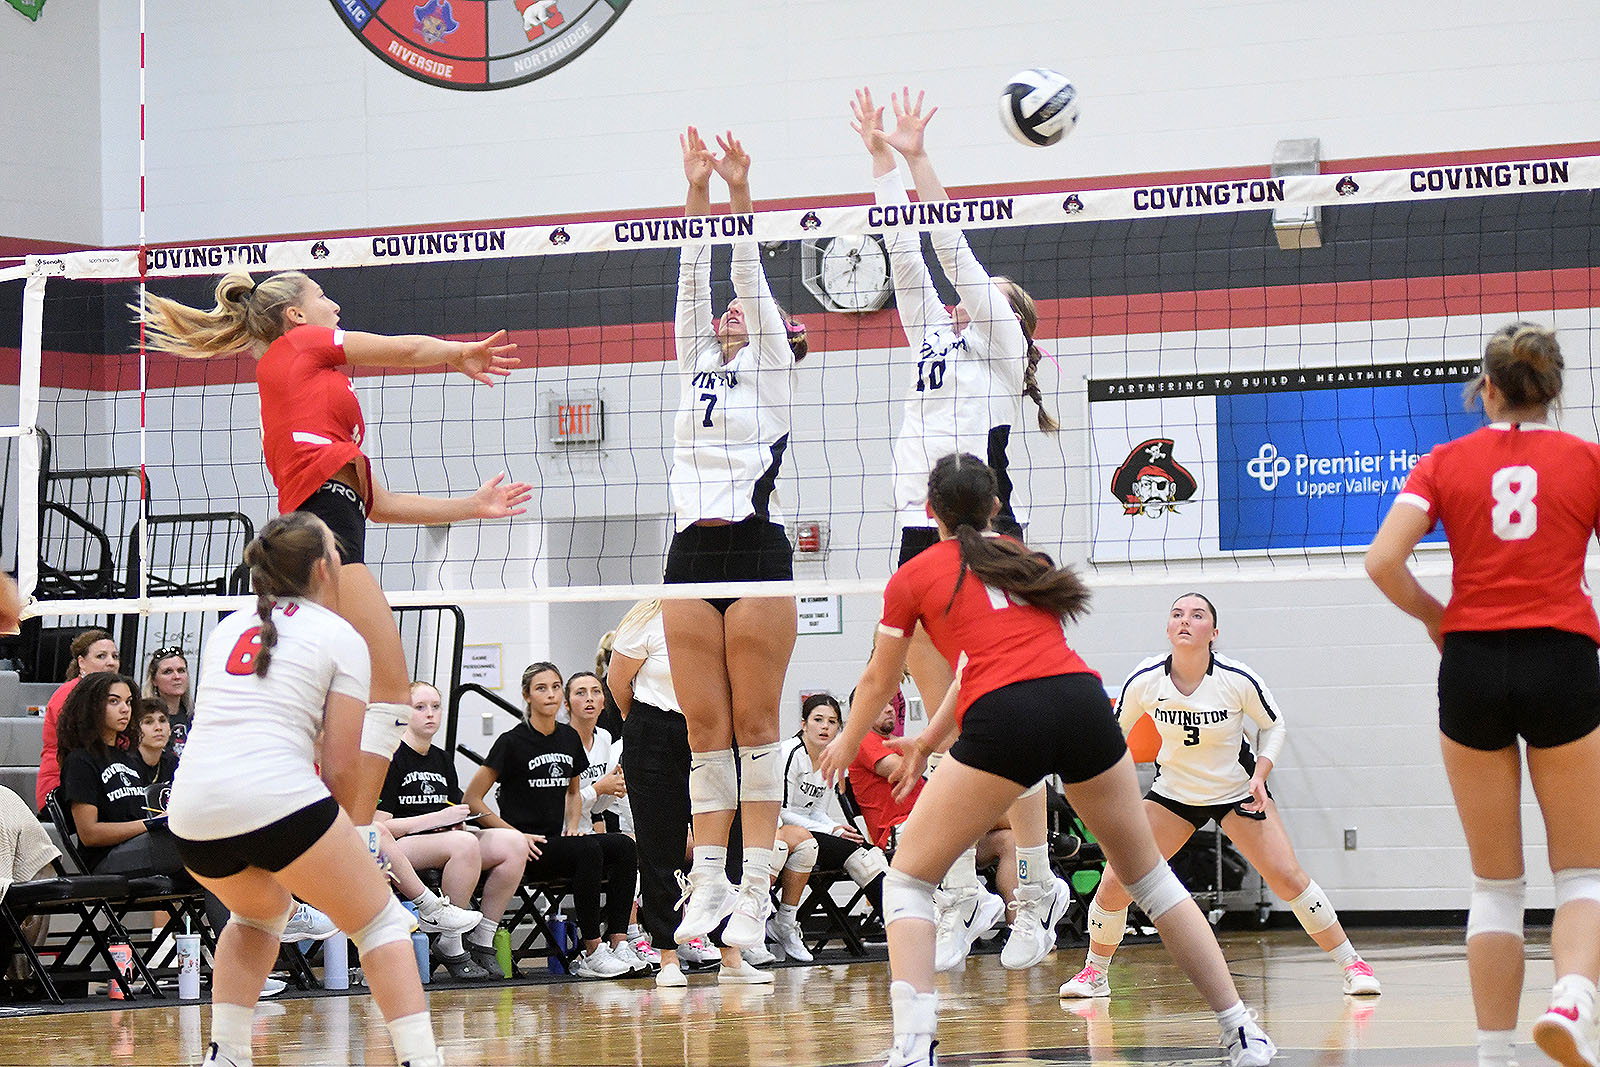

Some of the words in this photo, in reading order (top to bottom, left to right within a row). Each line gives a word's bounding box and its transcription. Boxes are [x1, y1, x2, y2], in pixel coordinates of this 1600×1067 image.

[388, 41, 454, 78] RIVERSIDE
[513, 21, 593, 73] NORTHRIDGE
[1410, 161, 1569, 193] COVINGTON
[1134, 179, 1286, 211] COVINGTON
[868, 198, 1014, 227] COVINGTON
[372, 230, 506, 257] COVINGTON
[615, 214, 754, 243] COVINGTON
[916, 359, 946, 392] 10
[1109, 381, 1204, 394] PARTNERING
[1215, 379, 1232, 388] TO
[1242, 376, 1288, 388] BUILD
[1299, 374, 1306, 383] A
[1316, 370, 1403, 383] HEALTHIER
[1413, 365, 1481, 377] COMMUN
[558, 404, 592, 435] EXIT
[700, 393, 718, 427] 7
[1296, 450, 1384, 476] Premier
[1390, 449, 1431, 472] He
[1296, 479, 1343, 499] Upper
[1345, 476, 1389, 496] Valley
[1492, 465, 1538, 541] 8
[1154, 707, 1229, 726] COVINGTON
[1183, 725, 1200, 747] 3
